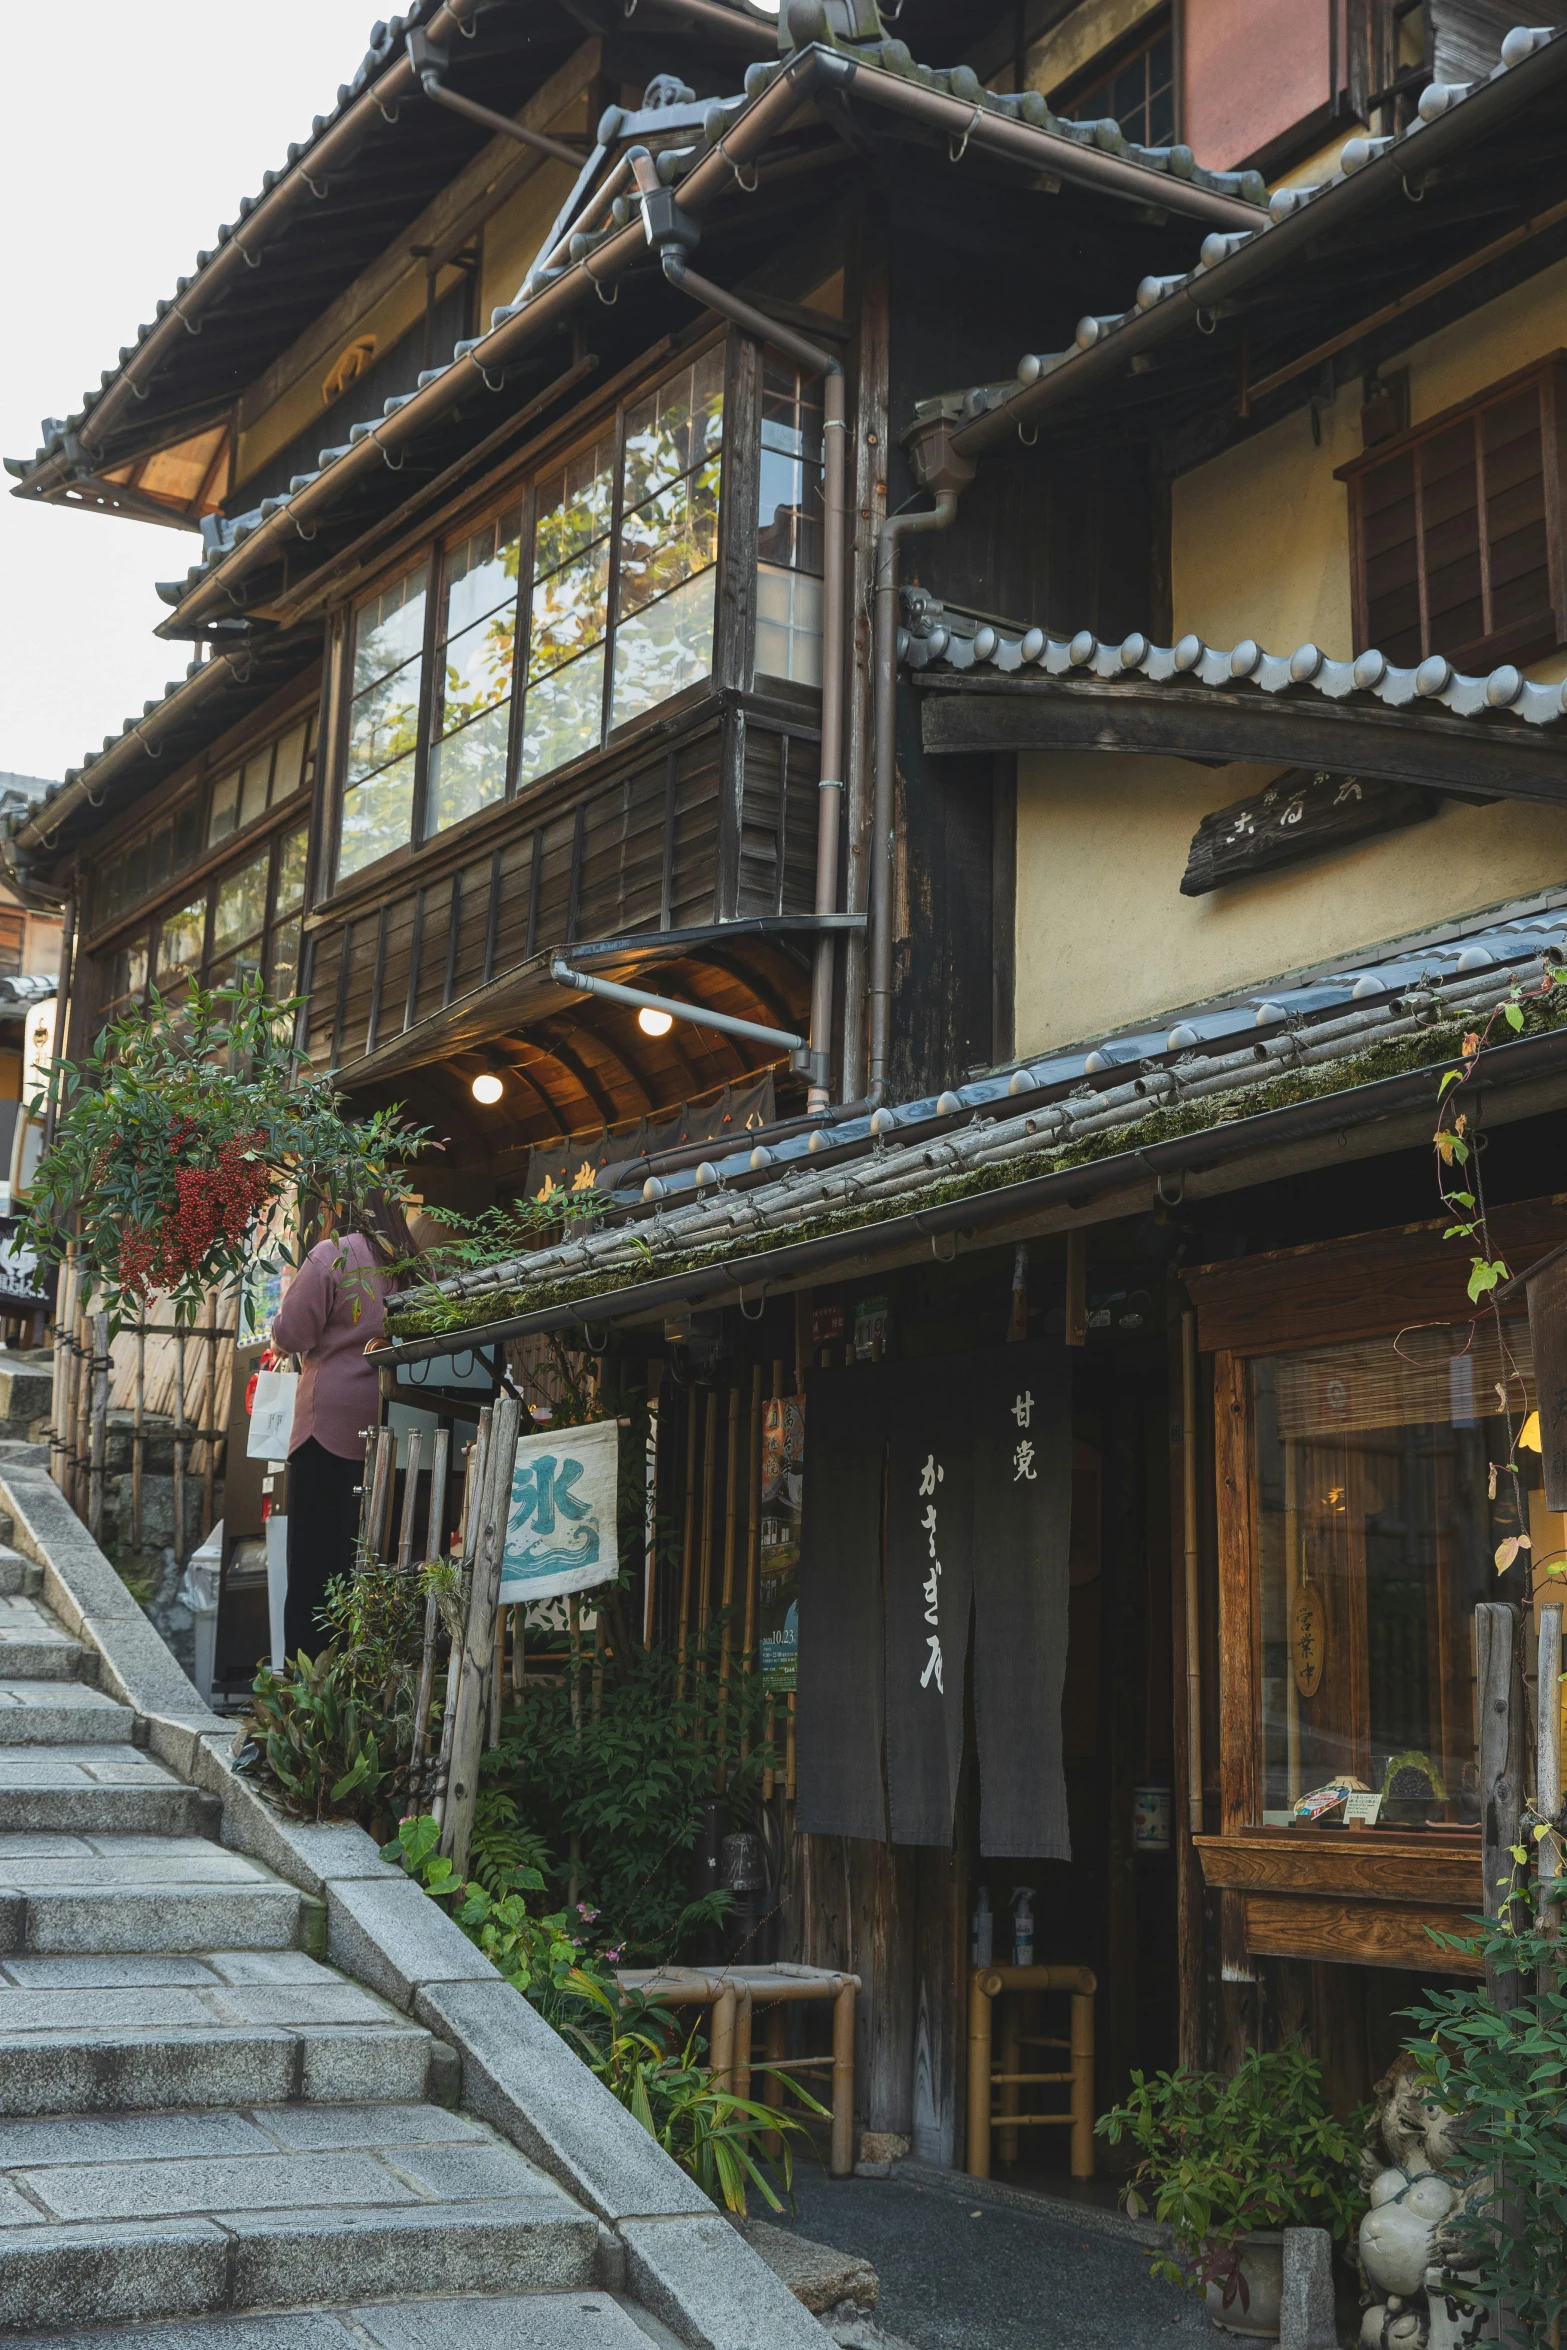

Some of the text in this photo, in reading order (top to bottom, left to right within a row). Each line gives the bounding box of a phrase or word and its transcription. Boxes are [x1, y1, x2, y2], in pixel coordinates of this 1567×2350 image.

[780, 1407, 794, 1482] 高台寺
[1010, 1390, 1037, 1482] 甘党
[508, 1454, 593, 1535] 氷
[772, 1629, 794, 1645] 10.23
[1296, 1607, 1316, 1687] 営業中
